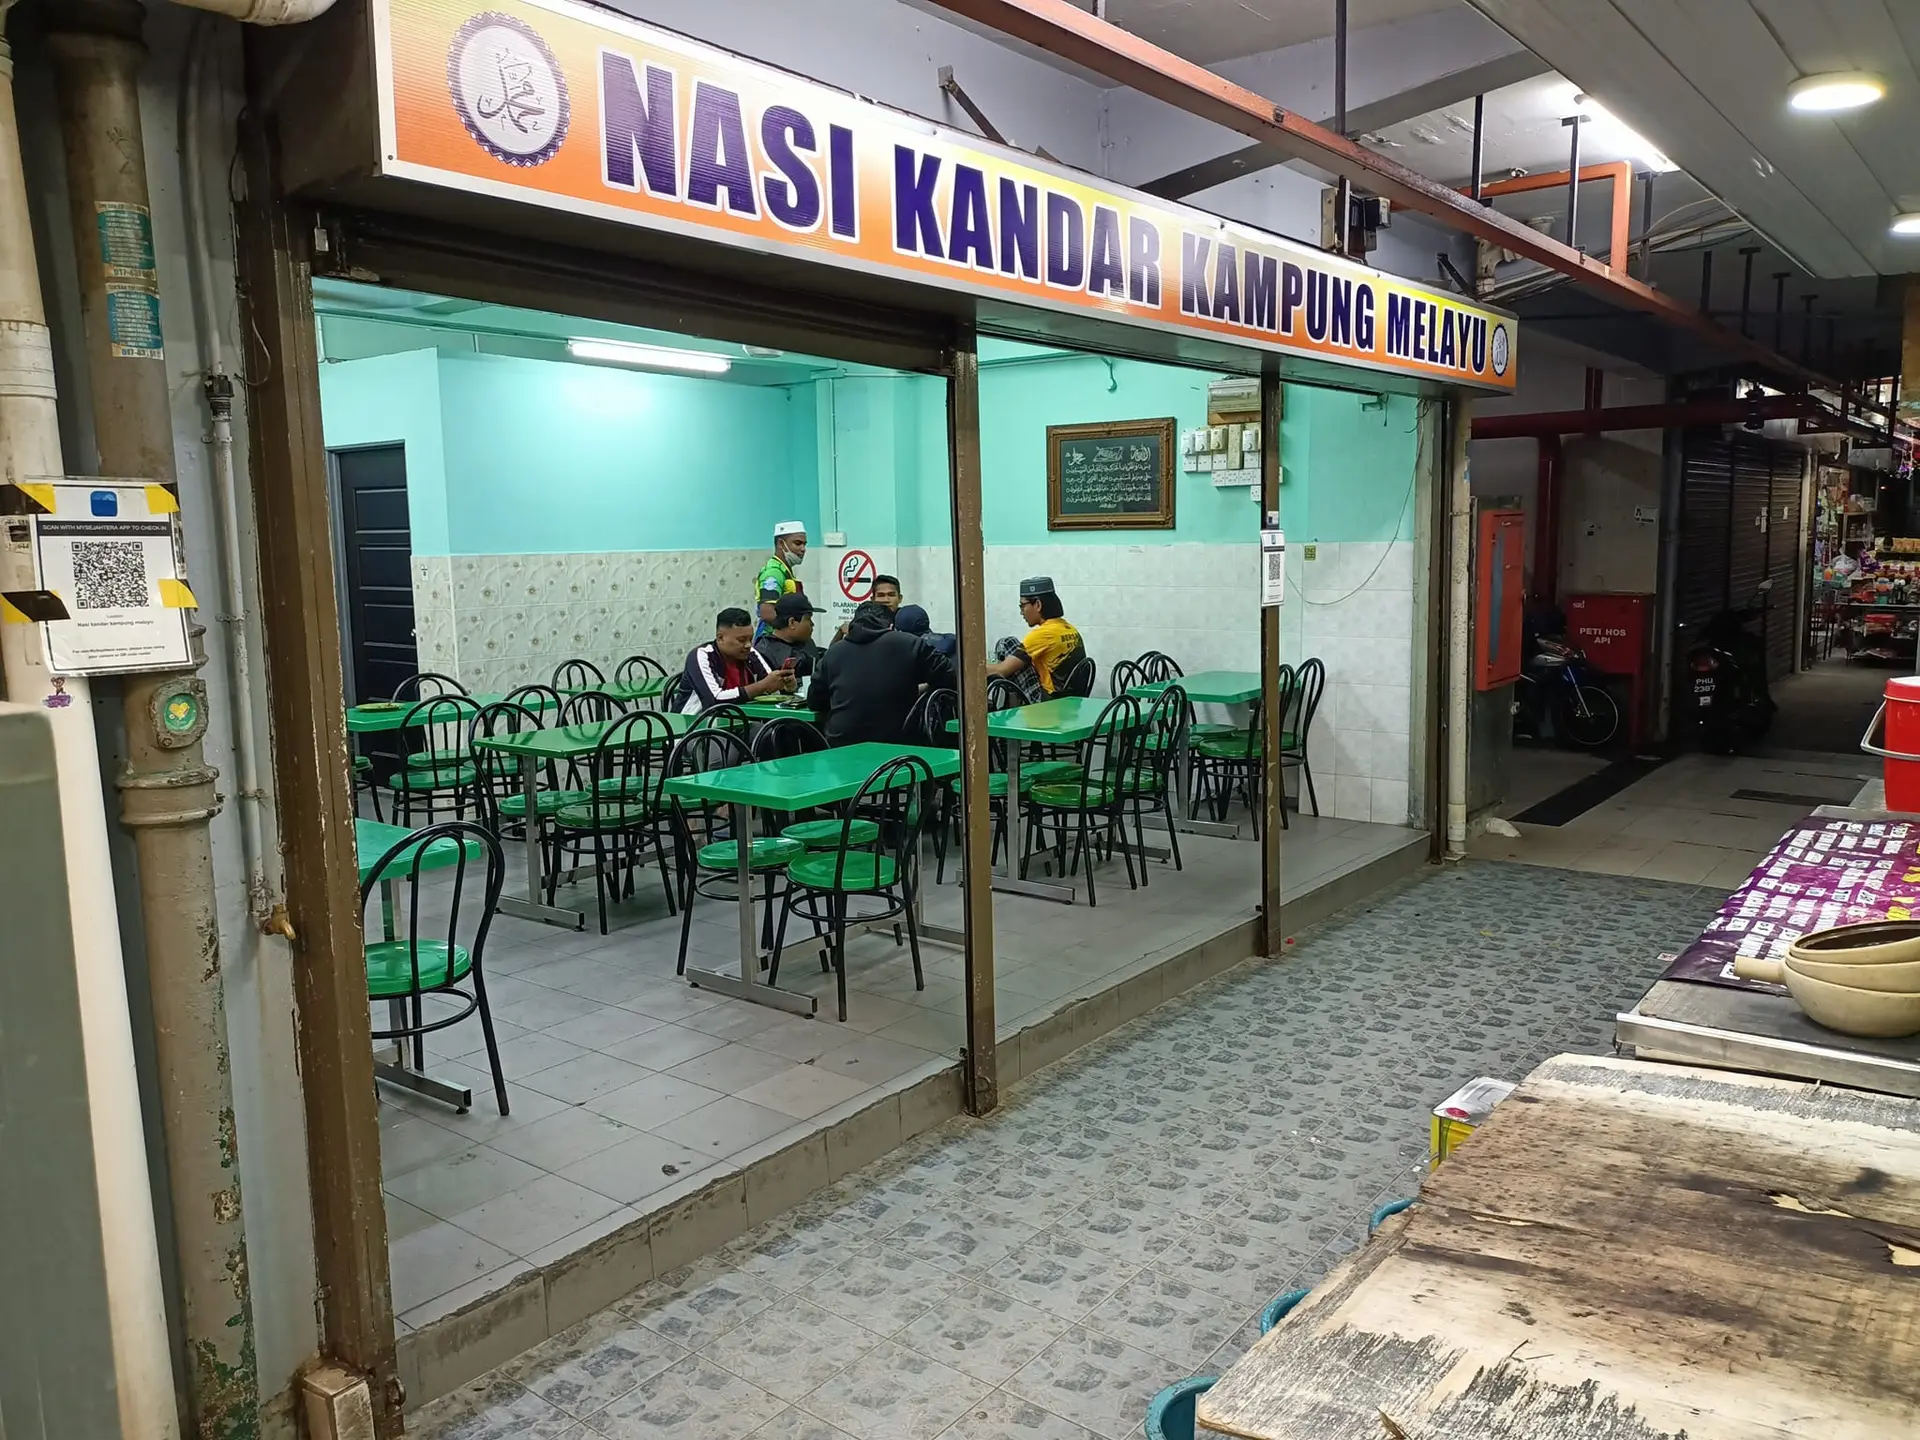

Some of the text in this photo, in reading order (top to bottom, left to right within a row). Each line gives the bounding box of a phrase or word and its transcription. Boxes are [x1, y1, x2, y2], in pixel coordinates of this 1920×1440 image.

[601, 50, 1488, 374] NASI KANDAR KAMPUNG MELAYU
[1579, 627, 1627, 637] PETI HOS
[1594, 636, 1611, 645] API
